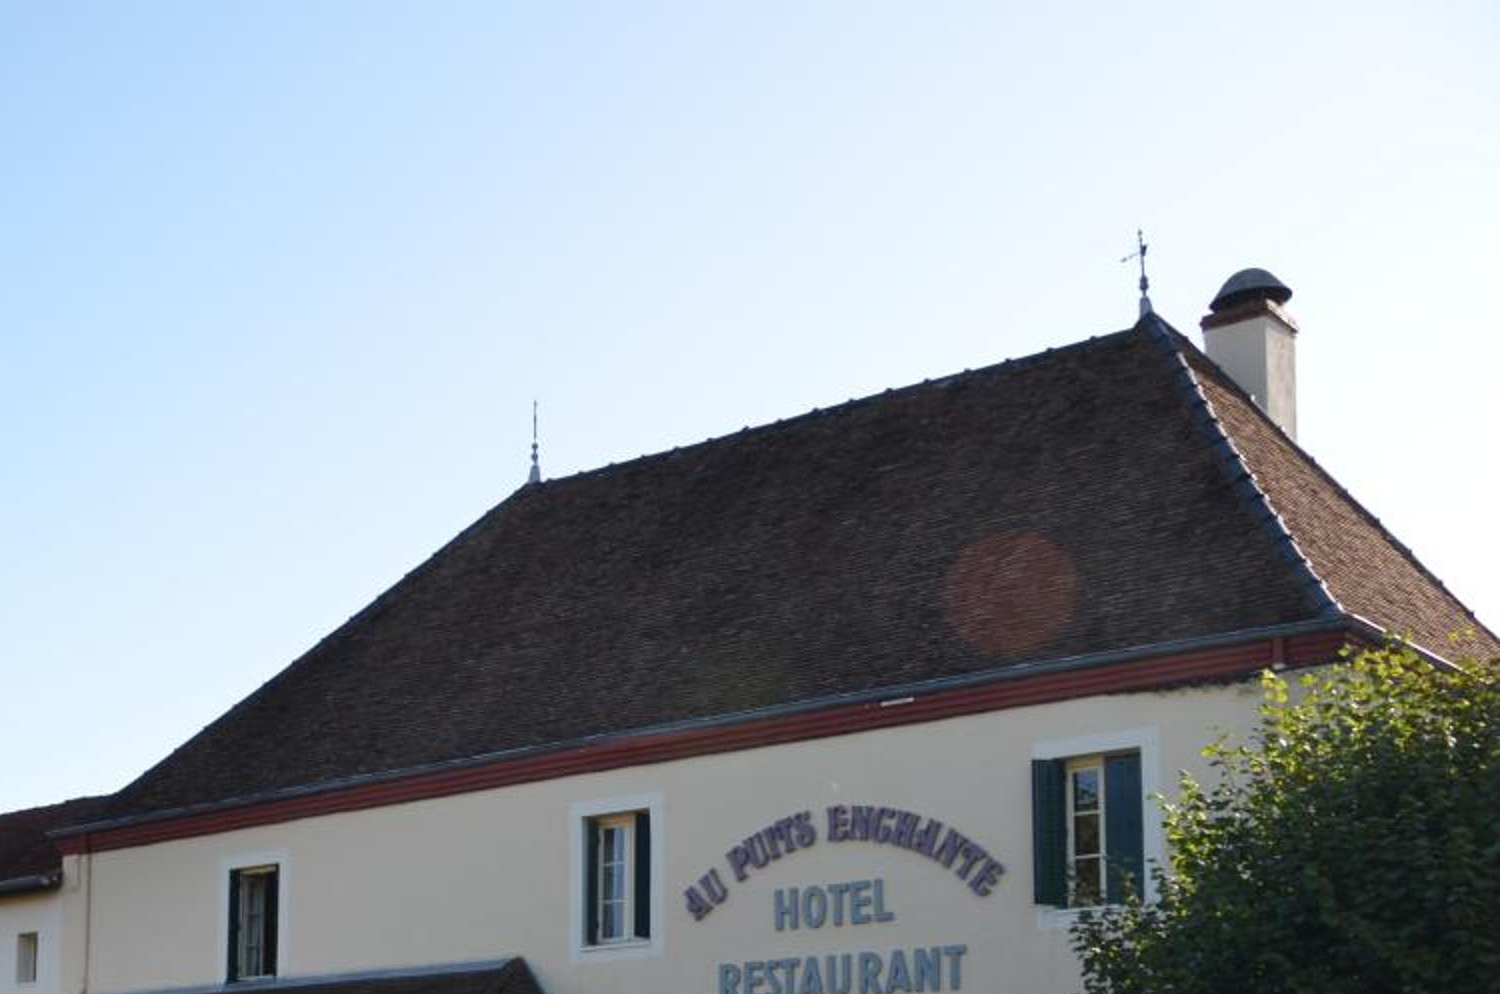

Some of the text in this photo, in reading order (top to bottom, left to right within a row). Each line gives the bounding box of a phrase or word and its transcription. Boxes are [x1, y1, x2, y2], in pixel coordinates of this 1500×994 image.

[683, 868, 729, 922] AU
[725, 809, 817, 883] PUITS
[773, 877, 895, 933] HOTEL
